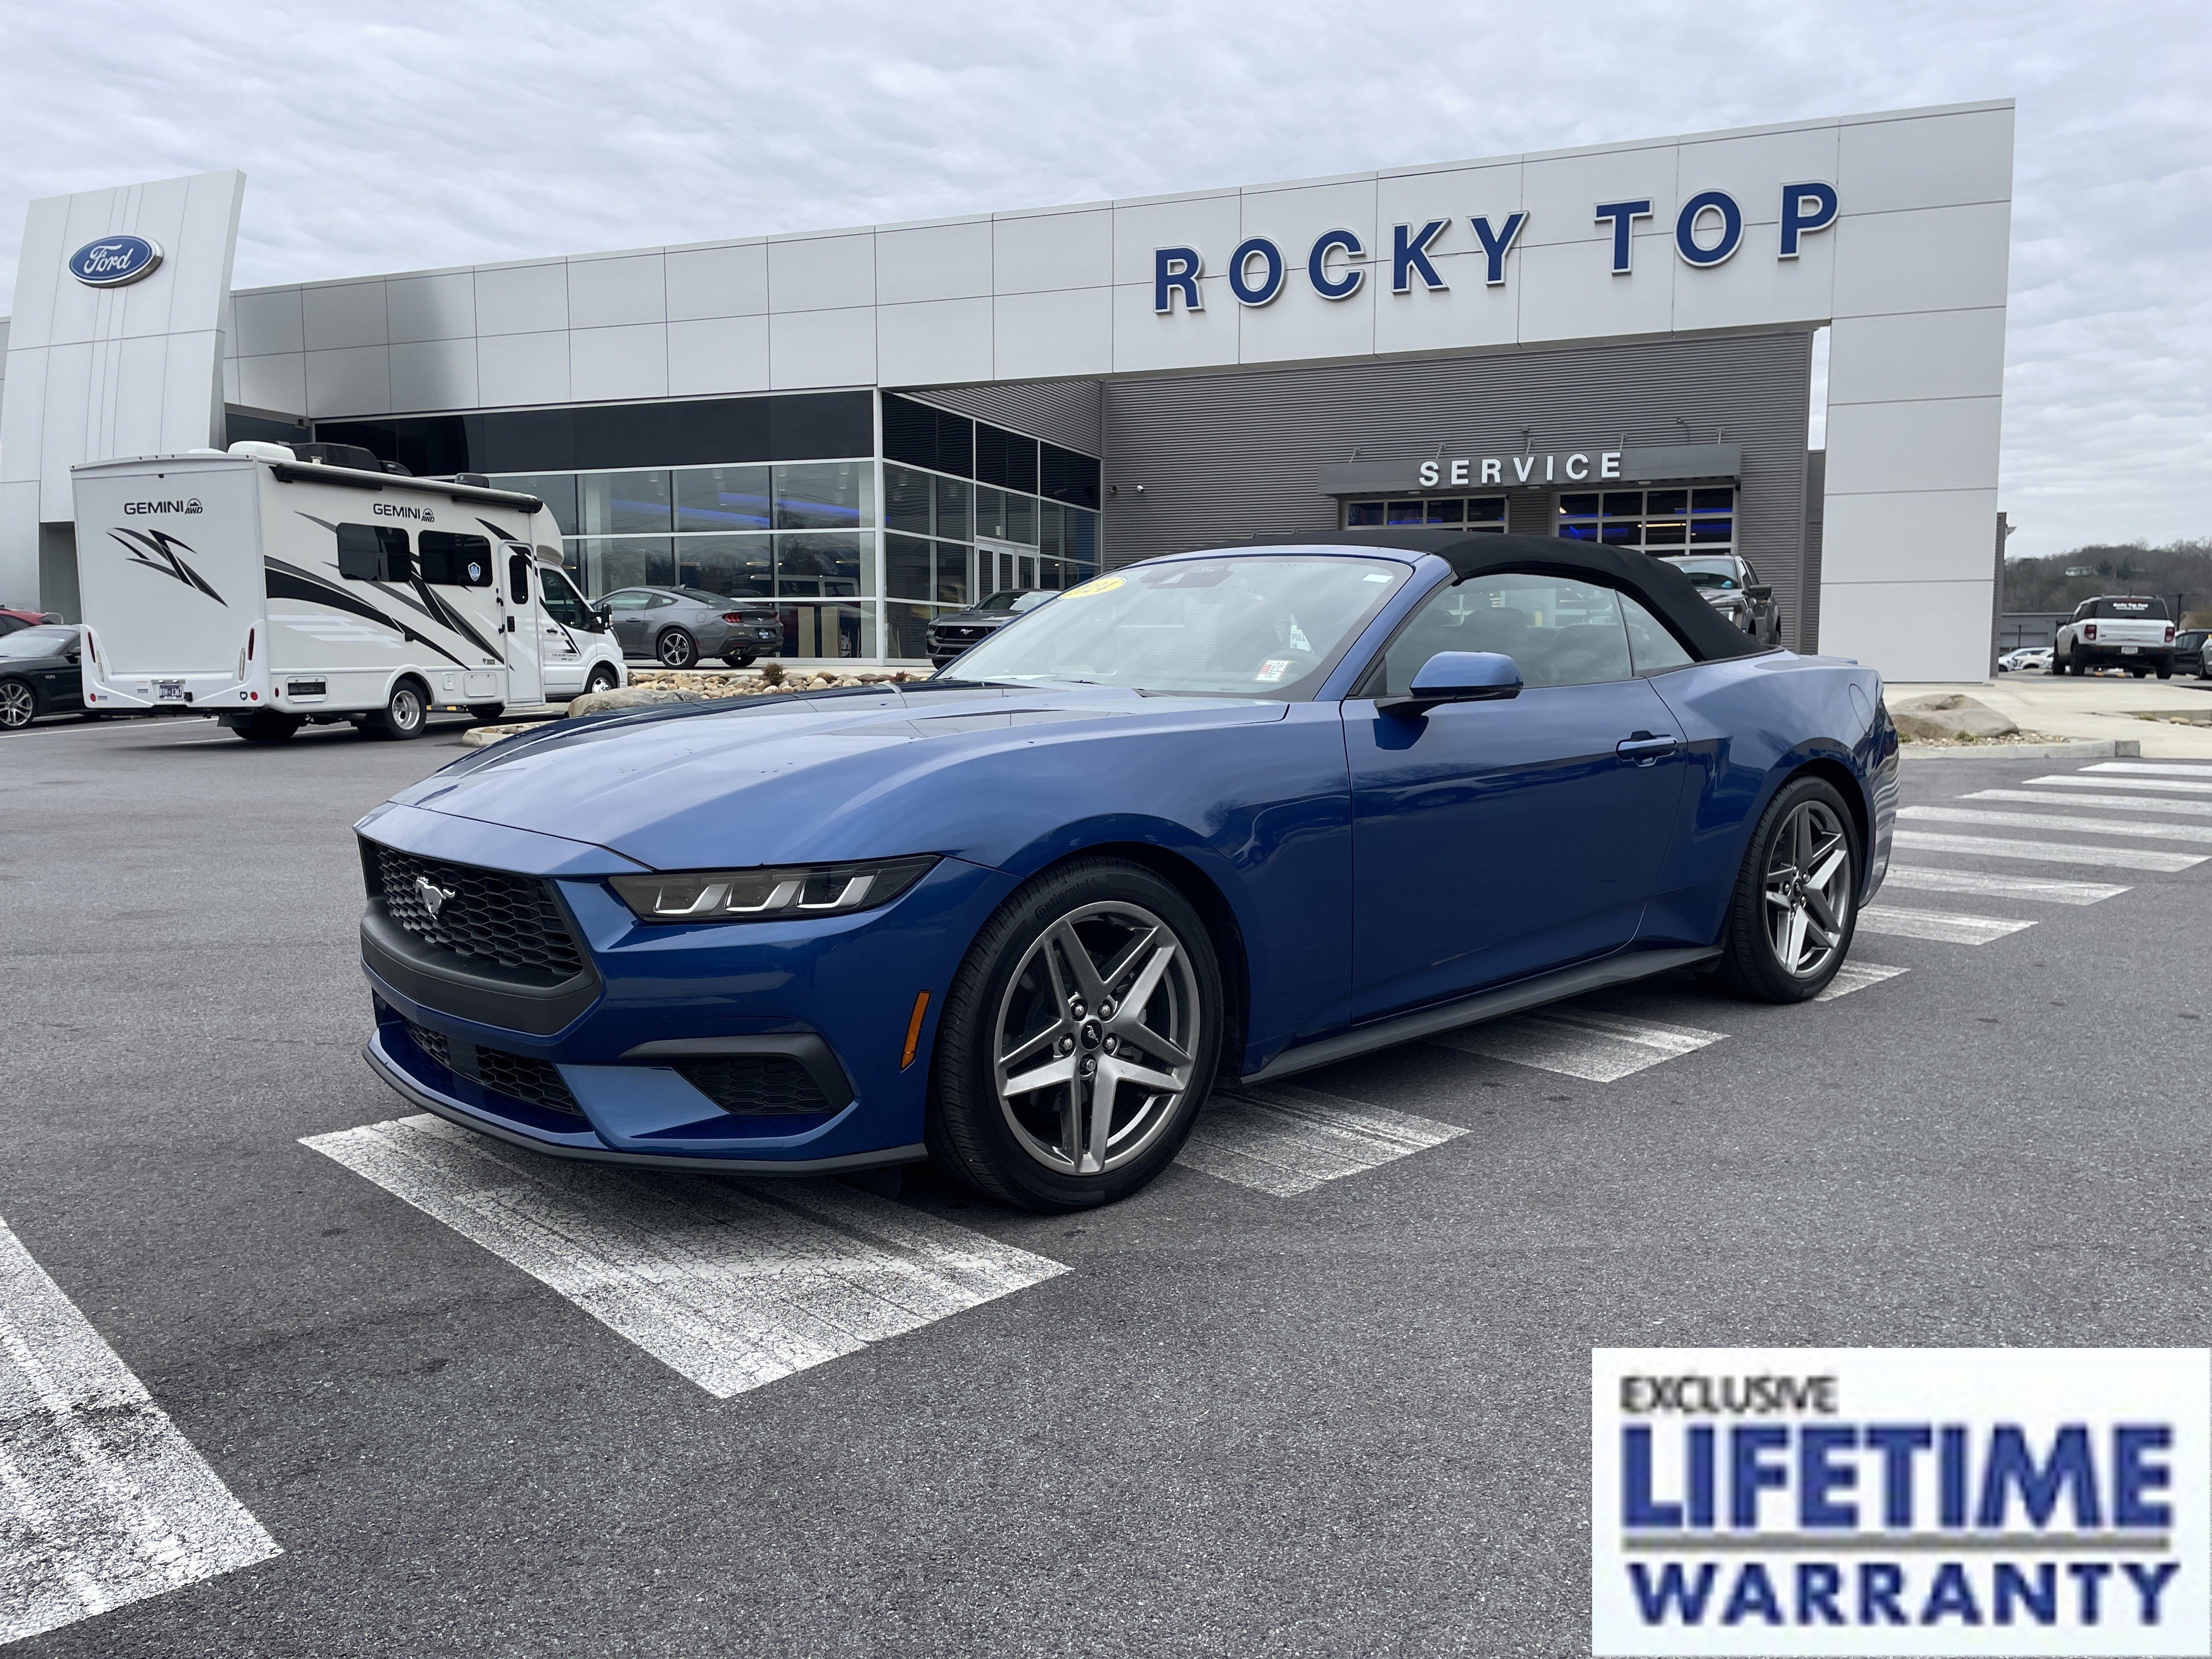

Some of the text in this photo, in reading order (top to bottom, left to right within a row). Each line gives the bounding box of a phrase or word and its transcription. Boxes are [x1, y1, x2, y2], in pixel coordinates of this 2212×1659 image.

[83, 244, 134, 274] Ford
[1152, 179, 1840, 314] ROCKY TOP
[1419, 451, 1622, 487] SERVICE
[124, 500, 203, 515] GEMINI AWD
[373, 503, 421, 520] GEMINI
[1292, 633, 1306, 641] PULL
[1035, 878, 1091, 921] Continental
